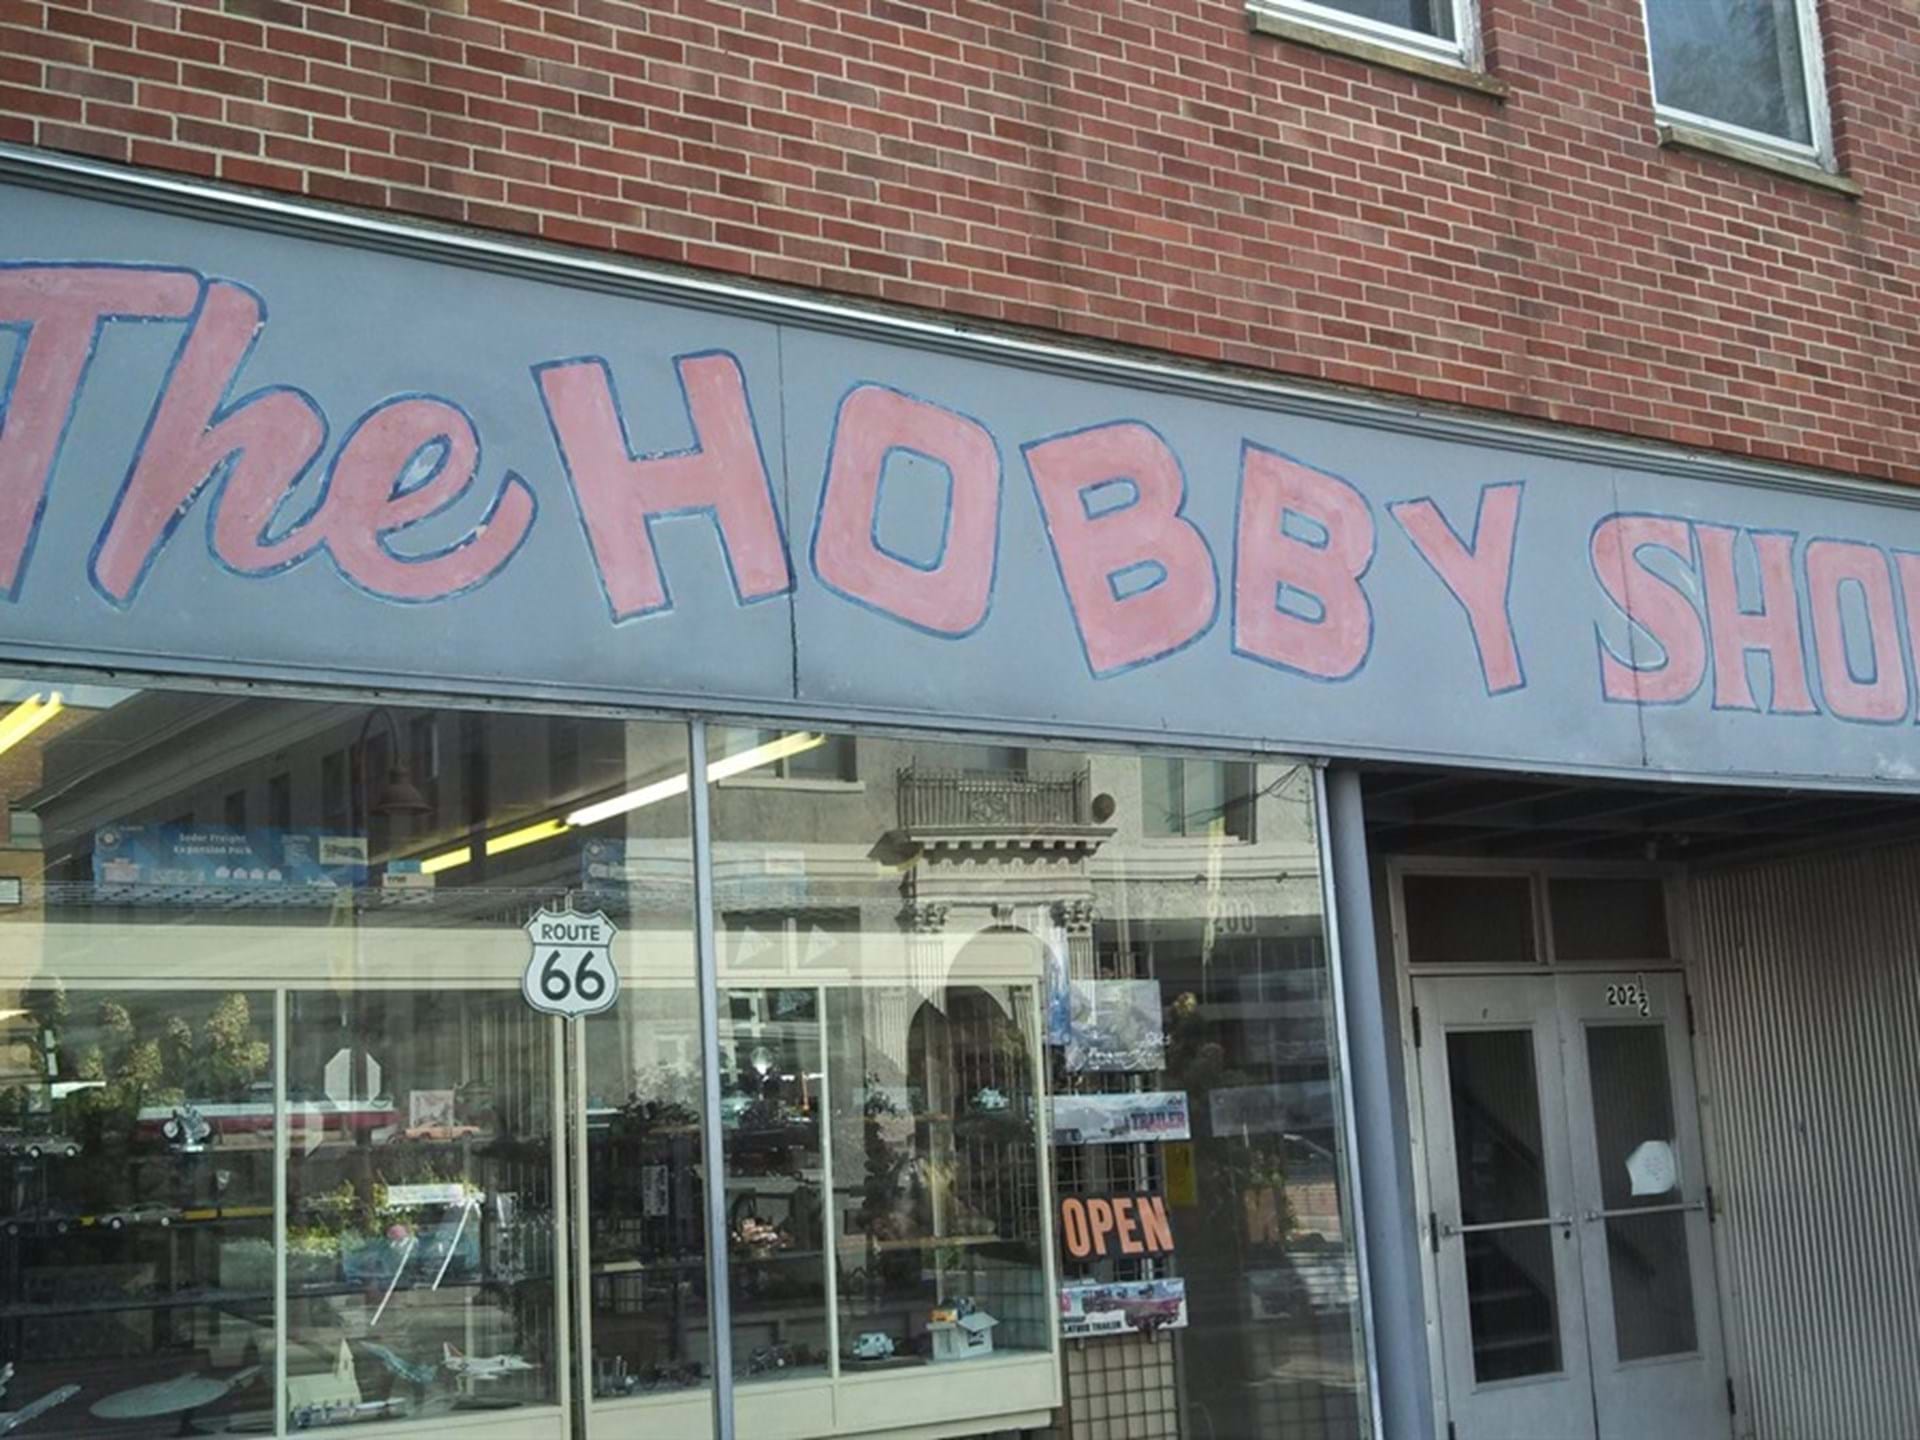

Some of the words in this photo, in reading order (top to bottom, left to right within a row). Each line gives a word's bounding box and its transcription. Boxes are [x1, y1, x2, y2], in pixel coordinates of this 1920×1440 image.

[0, 261, 537, 612] The
[530, 349, 1527, 696] HOBBY
[541, 923, 601, 941] ROUTE
[540, 949, 606, 1001] 66
[1062, 1196, 1175, 1257] OPEN
